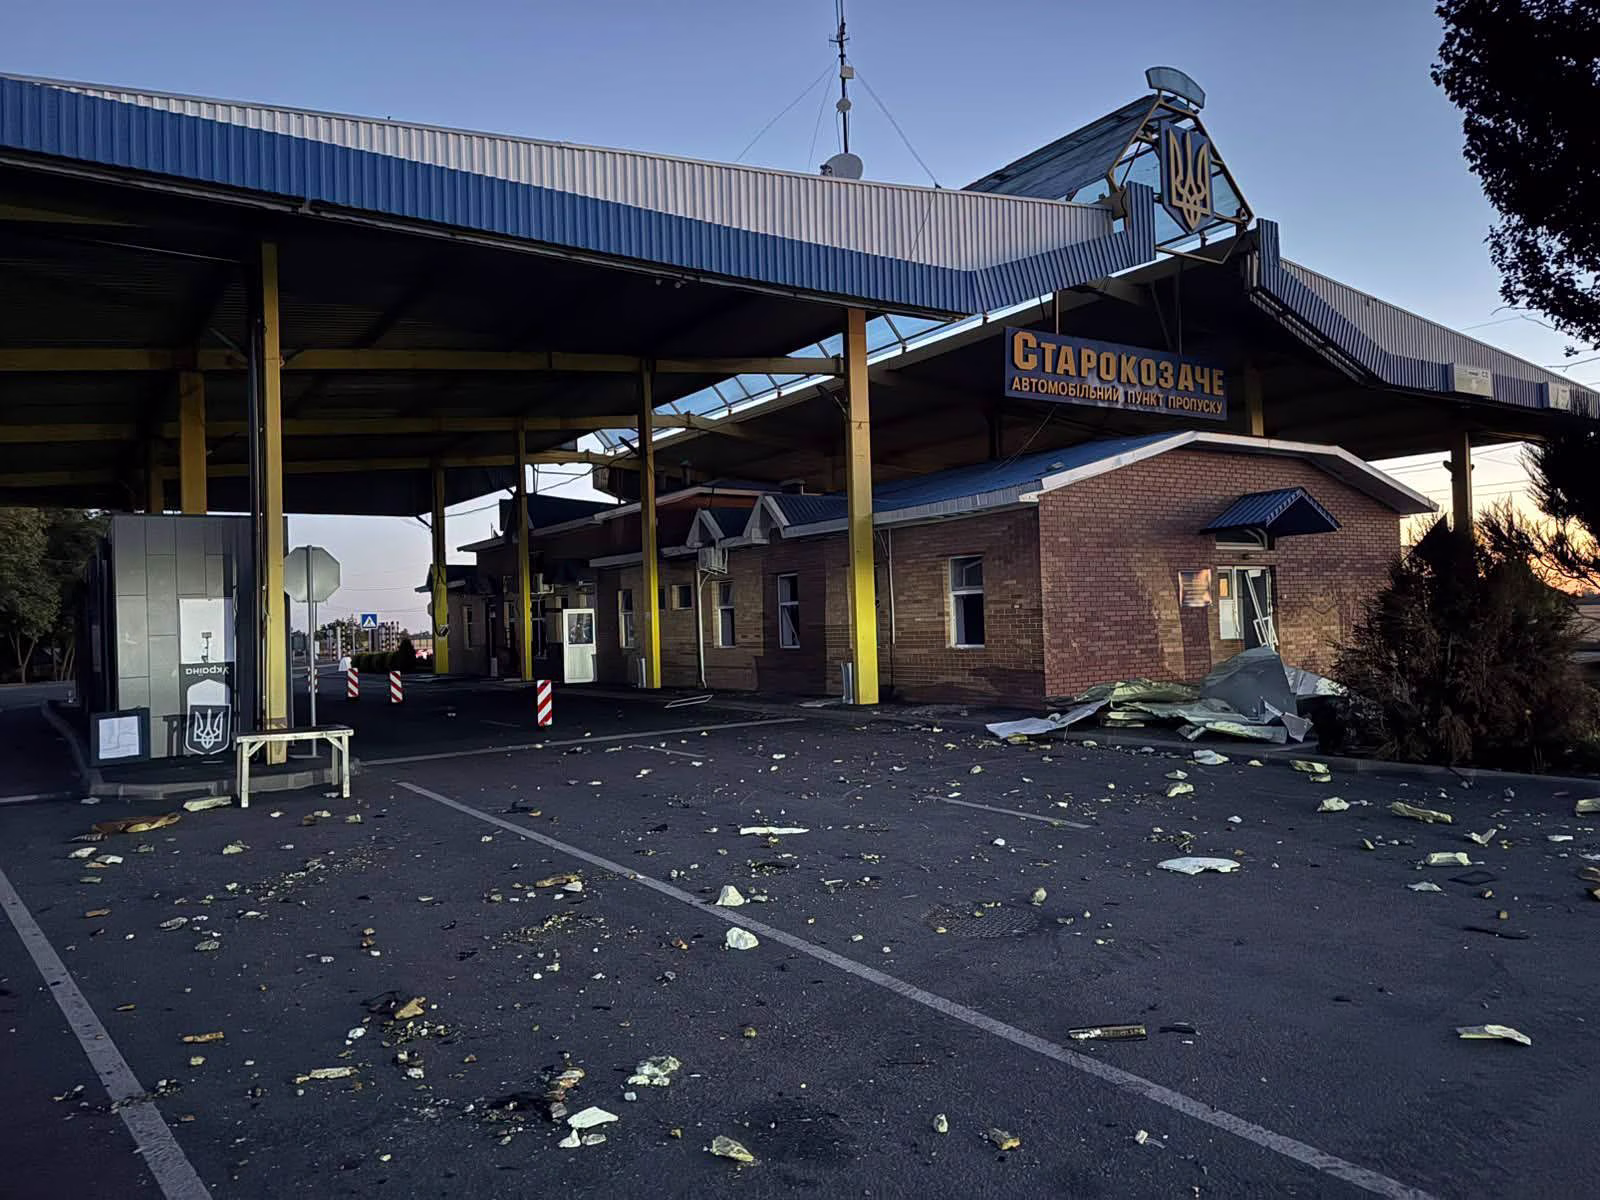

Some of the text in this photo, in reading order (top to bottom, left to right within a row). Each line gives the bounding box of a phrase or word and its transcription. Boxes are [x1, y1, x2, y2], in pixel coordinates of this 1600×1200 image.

[1127, 390, 1164, 407] ПУНКТ
[1168, 397, 1223, 415] ПРОПУСКУ
[185, 665, 230, 676] Україна
